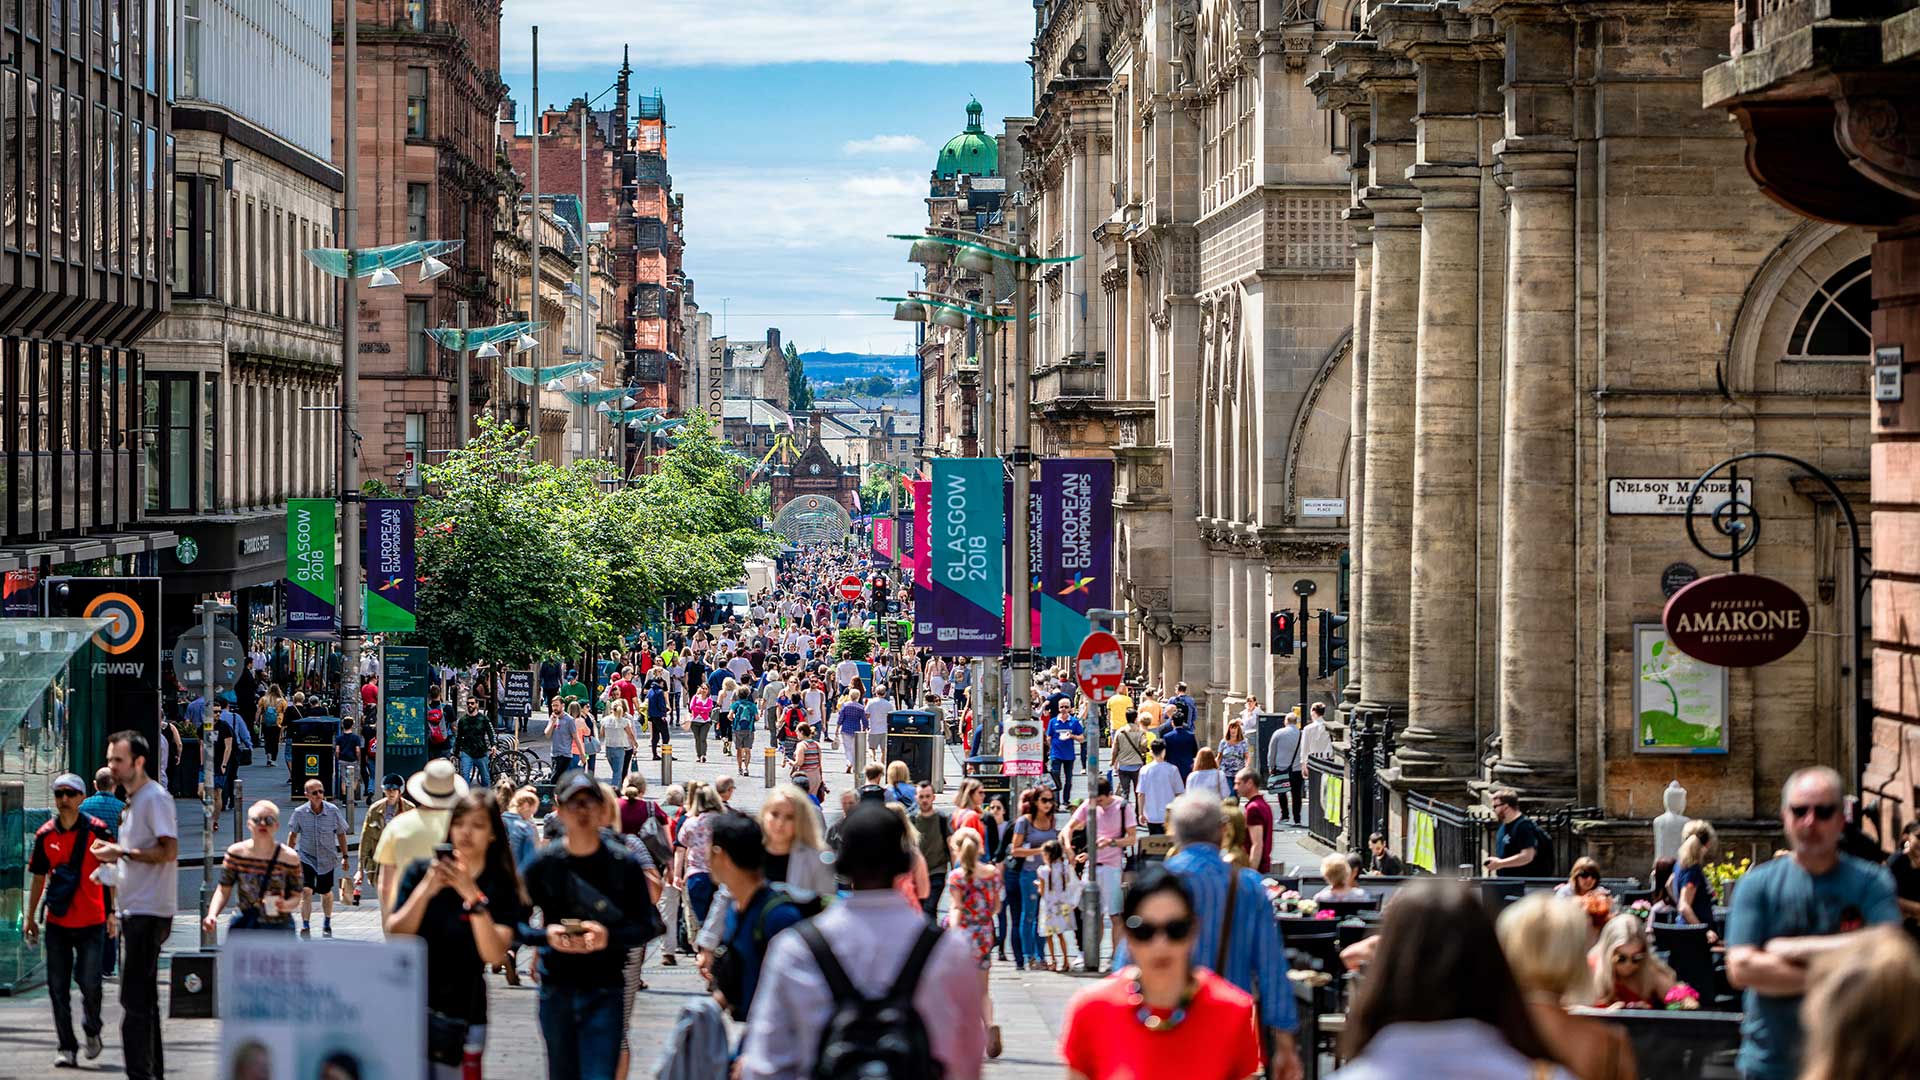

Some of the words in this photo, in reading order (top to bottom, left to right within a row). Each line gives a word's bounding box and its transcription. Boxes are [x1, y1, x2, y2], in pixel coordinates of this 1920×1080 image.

[709, 345, 722, 363] ST
[1616, 481, 1669, 493] NELSON
[1676, 481, 1744, 493] MNDELA
[381, 509, 392, 573] EUROPEAN
[392, 509, 401, 573] CHAMPIONSHIPS
[947, 474, 966, 581] GLASGOW
[1062, 473, 1079, 568] EUROPEAN
[1080, 473, 1091, 568] CHAMPIONSHIPS
[297, 509, 310, 581] GLASGOW
[312, 550, 324, 581] 2018
[969, 535, 987, 581] 2018
[938, 629, 957, 639] HM
[1676, 610, 1801, 633] AMARONE
[1702, 633, 1775, 643] RISTORANTE
